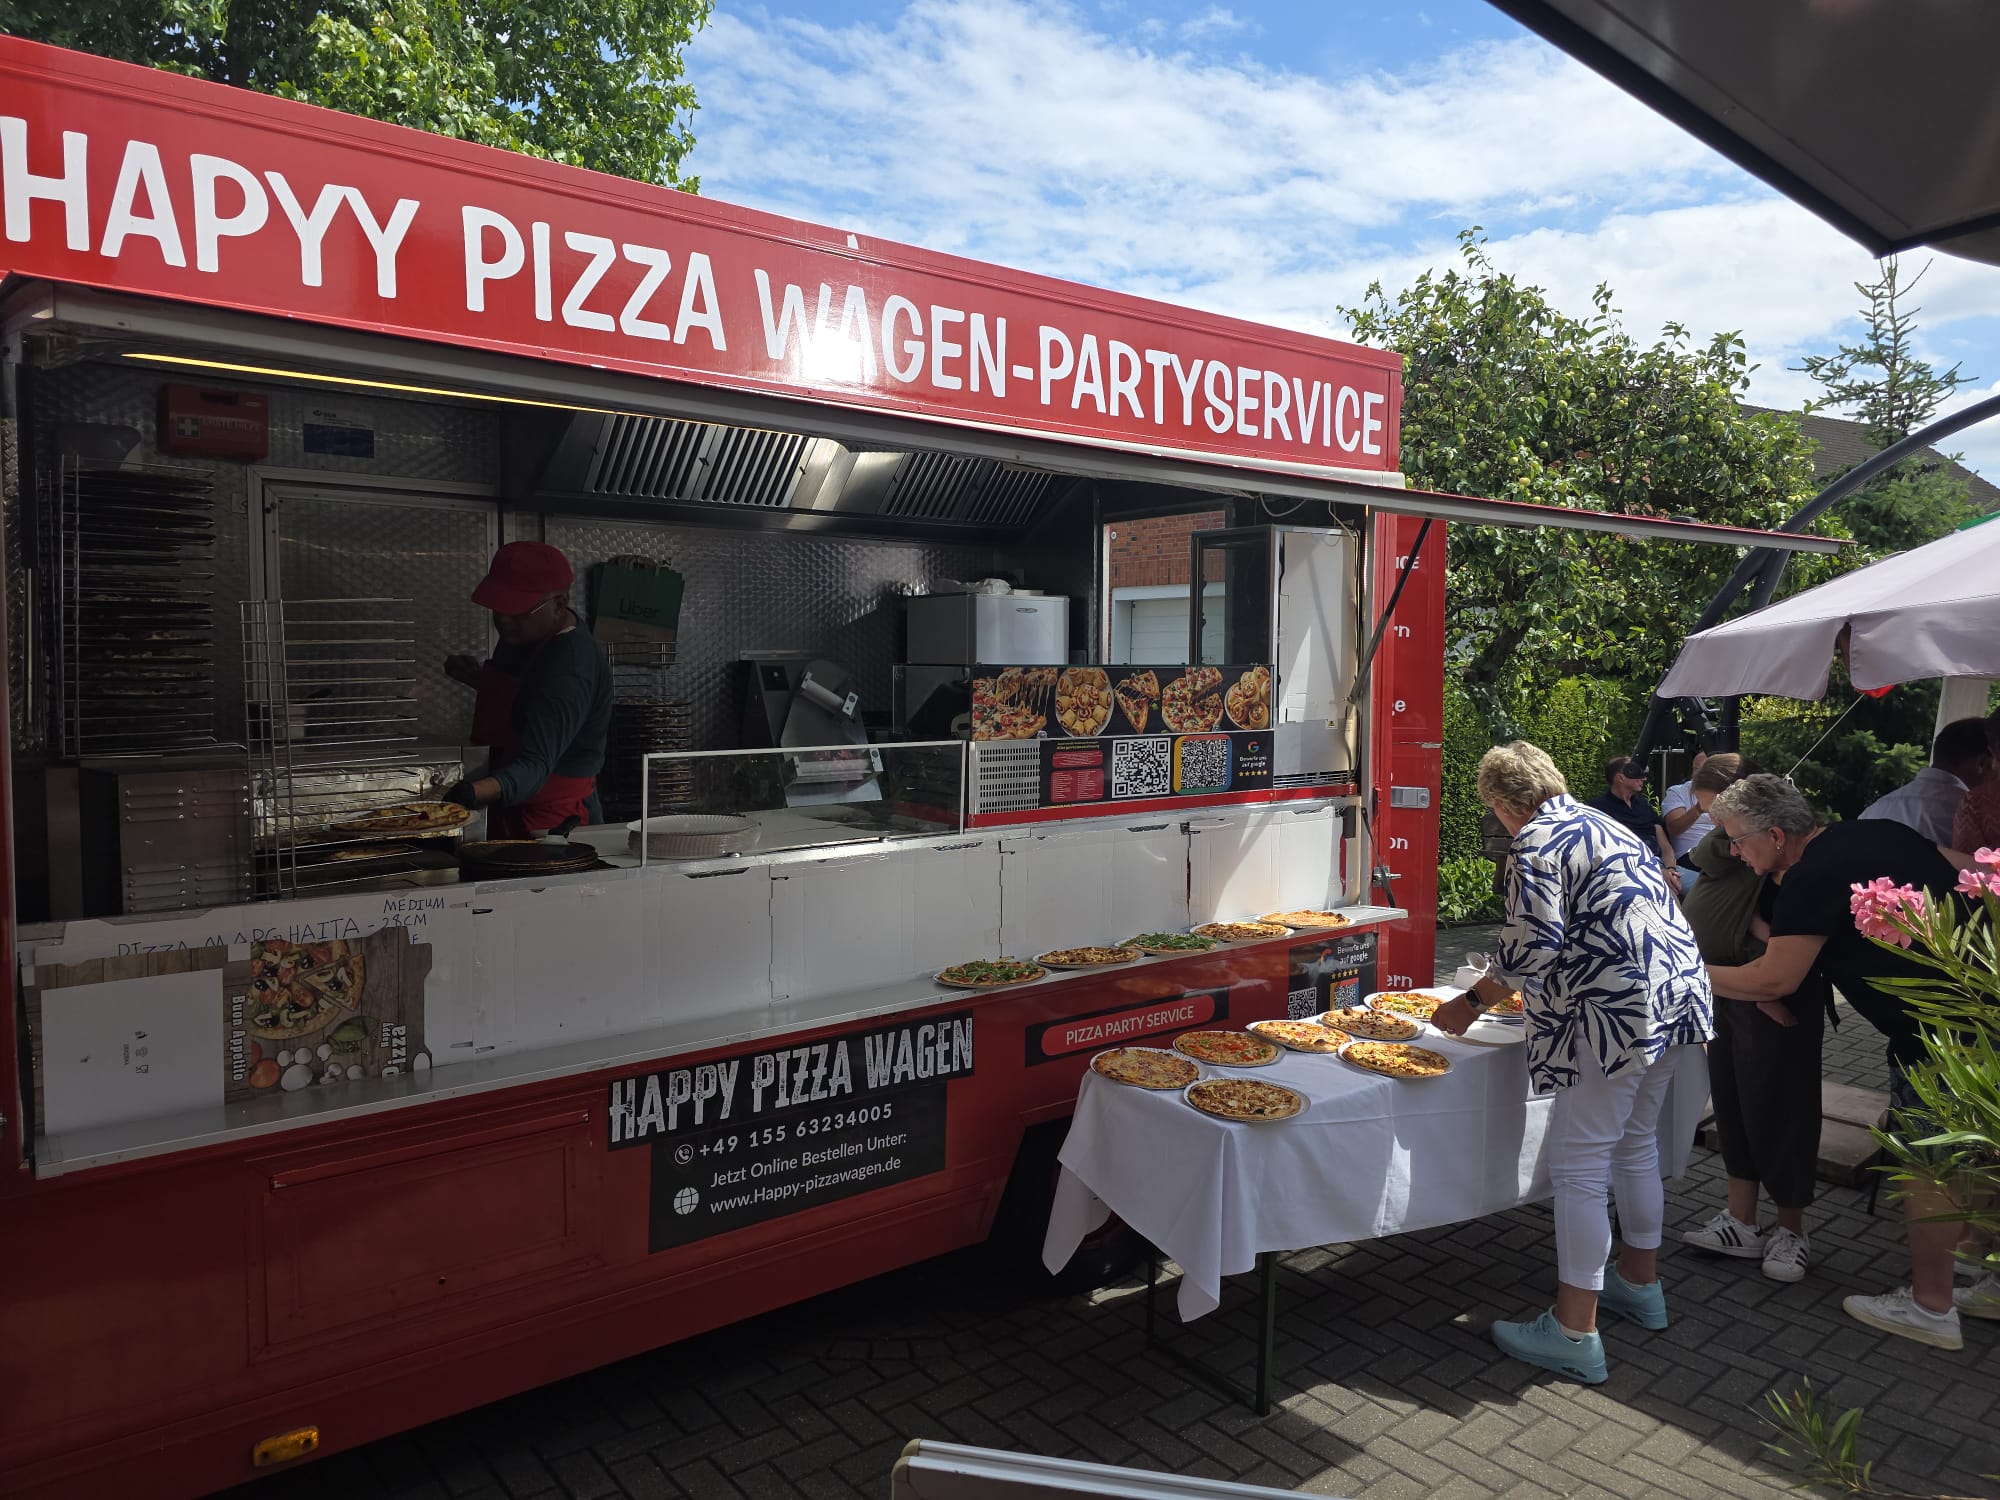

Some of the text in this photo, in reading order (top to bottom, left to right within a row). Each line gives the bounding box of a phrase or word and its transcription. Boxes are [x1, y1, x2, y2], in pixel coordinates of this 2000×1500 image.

[0, 116, 1384, 455] HAPYY PIZZA WAGEN-PARTYSERVICE
[619, 598, 661, 618] Uber
[383, 896, 445, 914] MEDIUM
[1350, 950, 1369, 964] google
[229, 995, 247, 1082] Buon Appetito
[380, 1022, 394, 1048] Happy
[1066, 1005, 1194, 1046] PIZZA PARTY SERVICE
[609, 1017, 974, 1143] HAPPY PIZZA WAGEN
[699, 1103, 893, 1157] +49 155 63234005
[710, 1131, 907, 1188] Jetzt Online Bestellen Unter:
[710, 1156, 902, 1214] www.Happy-pizzawagen.de
